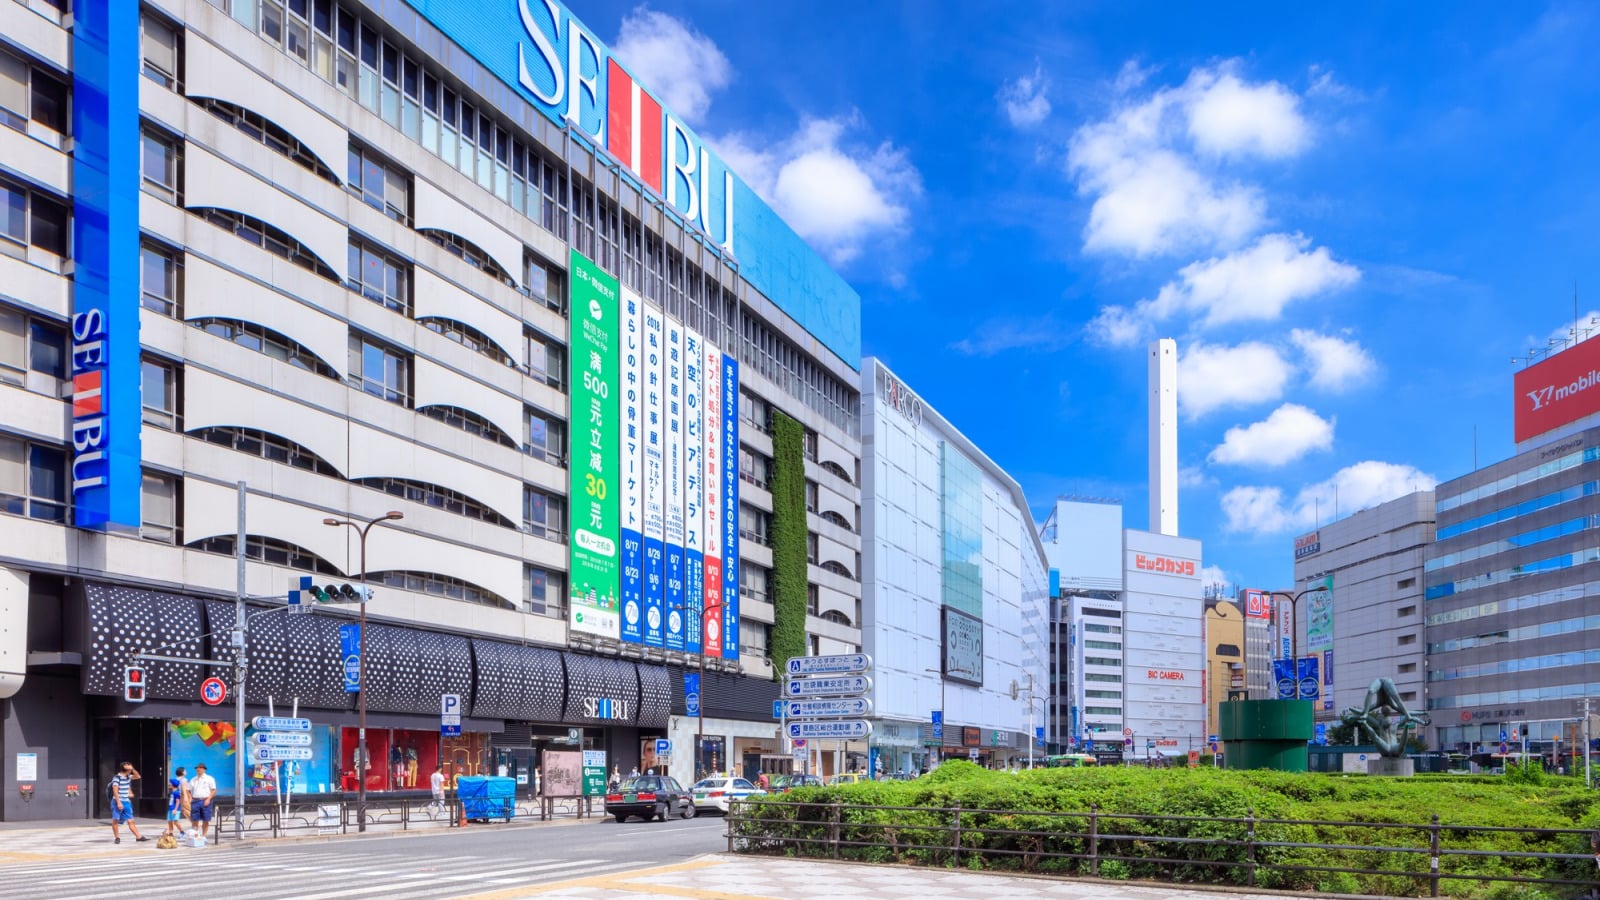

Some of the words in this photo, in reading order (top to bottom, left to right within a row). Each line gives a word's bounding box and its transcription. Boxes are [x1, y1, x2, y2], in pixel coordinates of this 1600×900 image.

[518, 0, 734, 256] SEIBU
[73, 308, 104, 495] SEIBU
[884, 372, 922, 427] PARCO
[627, 299, 636, 525] 暮らしの中の骨董マーケット
[688, 337, 696, 545] 天空のビアテラス
[625, 539, 639, 553] 8/17
[670, 554, 679, 565] 8/7
[1136, 554, 1194, 576] ビックカメラ
[625, 566, 639, 580] 8/23
[648, 573, 660, 585] 9/6
[1160, 671, 1184, 680] CAMERA
[445, 696, 457, 713] P
[584, 697, 628, 720] SEIBU
[656, 741, 669, 754] P
